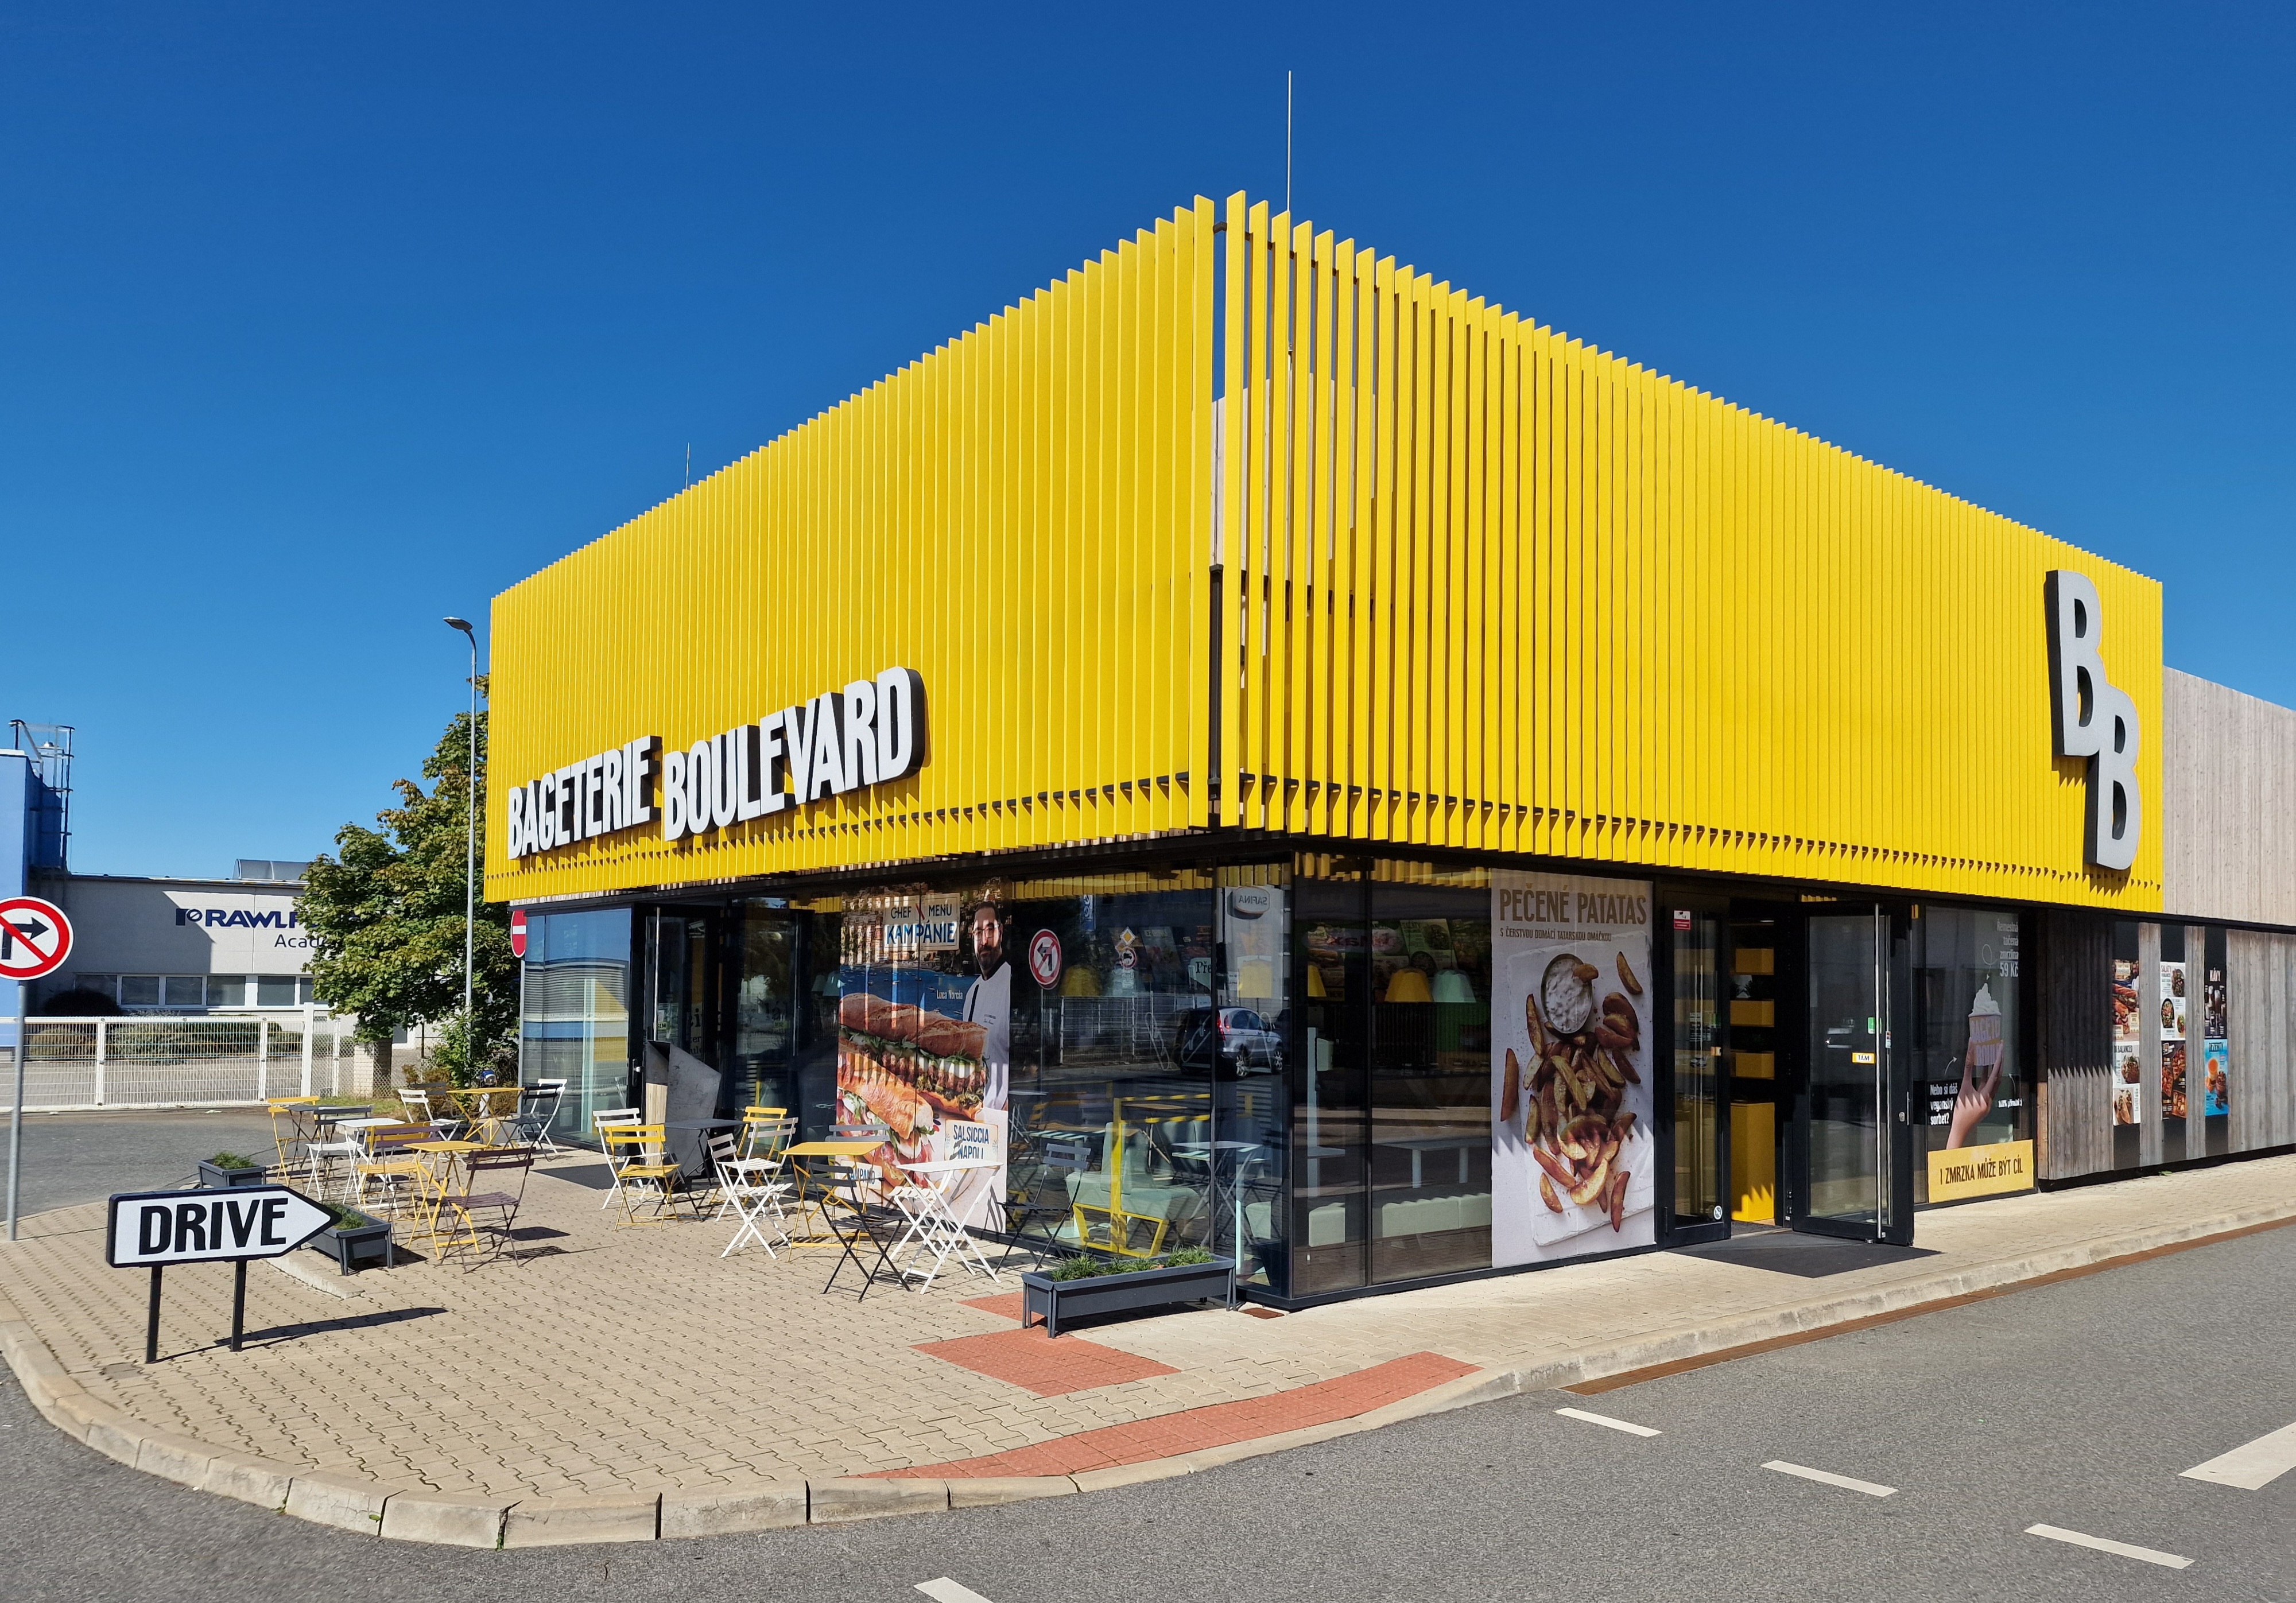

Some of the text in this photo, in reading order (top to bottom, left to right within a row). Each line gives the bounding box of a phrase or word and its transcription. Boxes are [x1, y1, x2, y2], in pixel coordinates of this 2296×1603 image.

[508, 666, 920, 860] BAGETERIE BOULEVARD
[890, 903, 952, 919] CHEF MENU
[1500, 882, 1647, 925] PEČENÉ PATATAS
[886, 919, 955, 944] KAMPÁNIE
[1500, 927, 1504, 937] S
[1506, 926, 1533, 938] ČERSTVOU
[1535, 928, 1556, 940] DOMÁCÍ
[1557, 930, 1585, 941] TATARSKOU
[2000, 961, 2019, 977] 59 Kč
[1930, 1082, 1958, 1096] Nebo si dáš
[1930, 1097, 1953, 1112] veganský
[1930, 1112, 1950, 1125] sorbet?
[953, 1124, 989, 1144] SALSICCIA
[1940, 1154, 2023, 1185] I ZMRZKA MŮŽE BÝT CÍL
[138, 1197, 288, 1256] DRIVE
